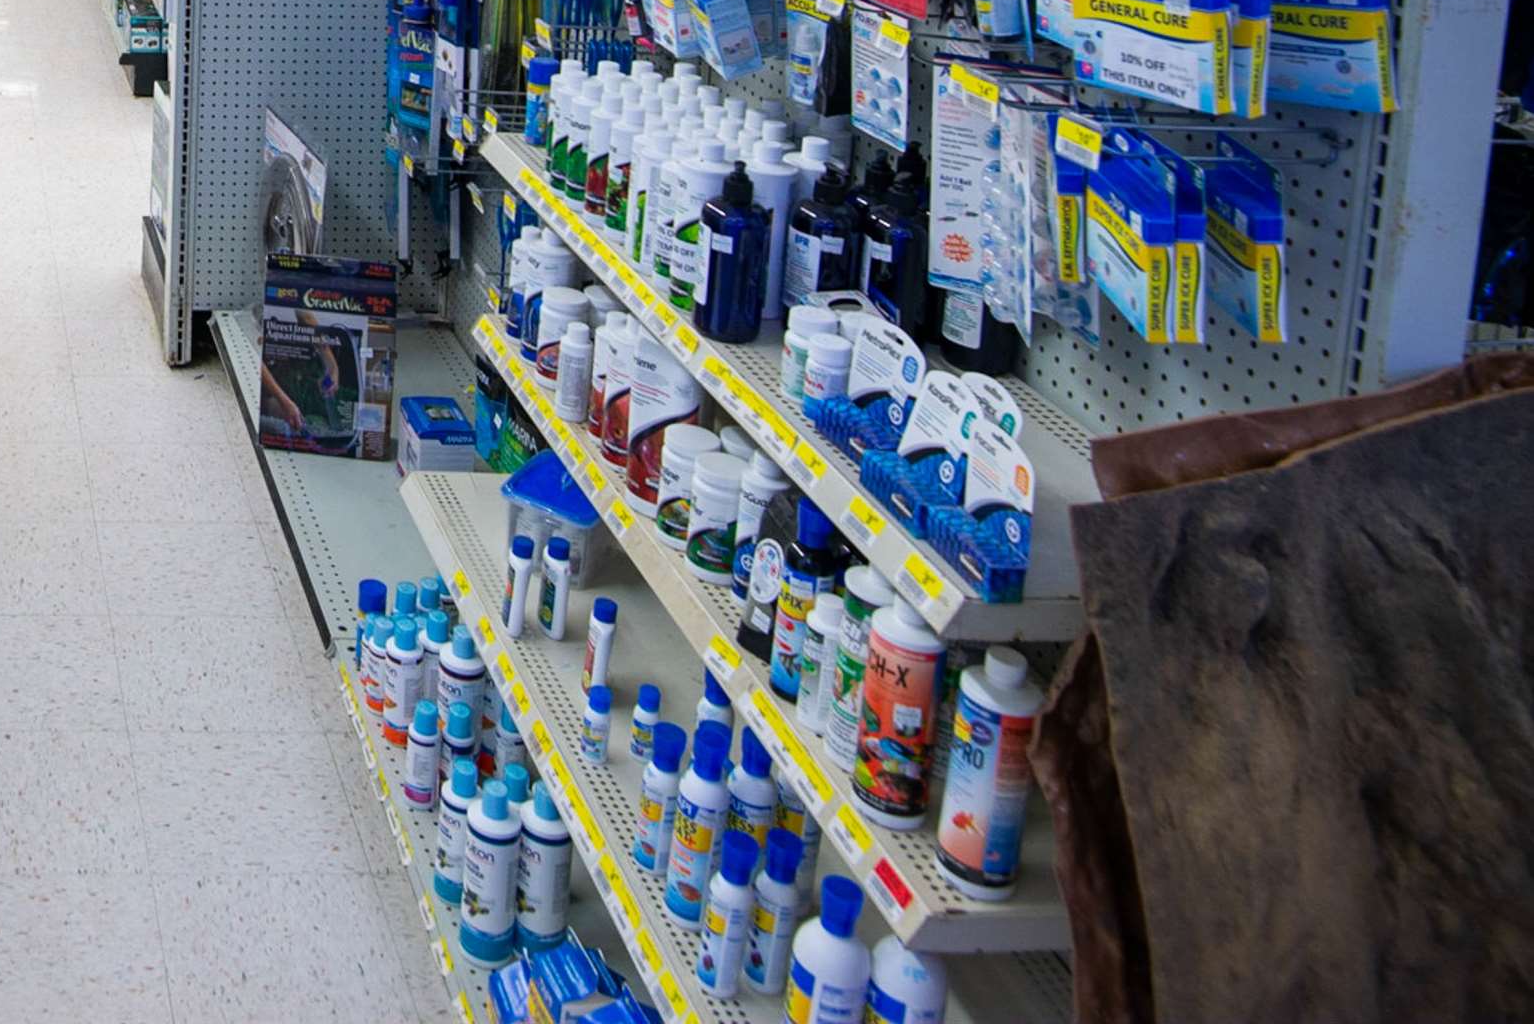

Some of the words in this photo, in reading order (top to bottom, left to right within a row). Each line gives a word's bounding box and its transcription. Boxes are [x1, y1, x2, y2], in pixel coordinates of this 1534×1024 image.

[1152, 10, 1190, 29] CURE
[1308, 14, 1348, 30] CURE
[1119, 51, 1143, 68] 10%
[1145, 57, 1167, 73] OFF
[1102, 66, 1127, 84] THIS
[1127, 75, 1156, 91] ITEM
[1157, 81, 1187, 100] ONLY
